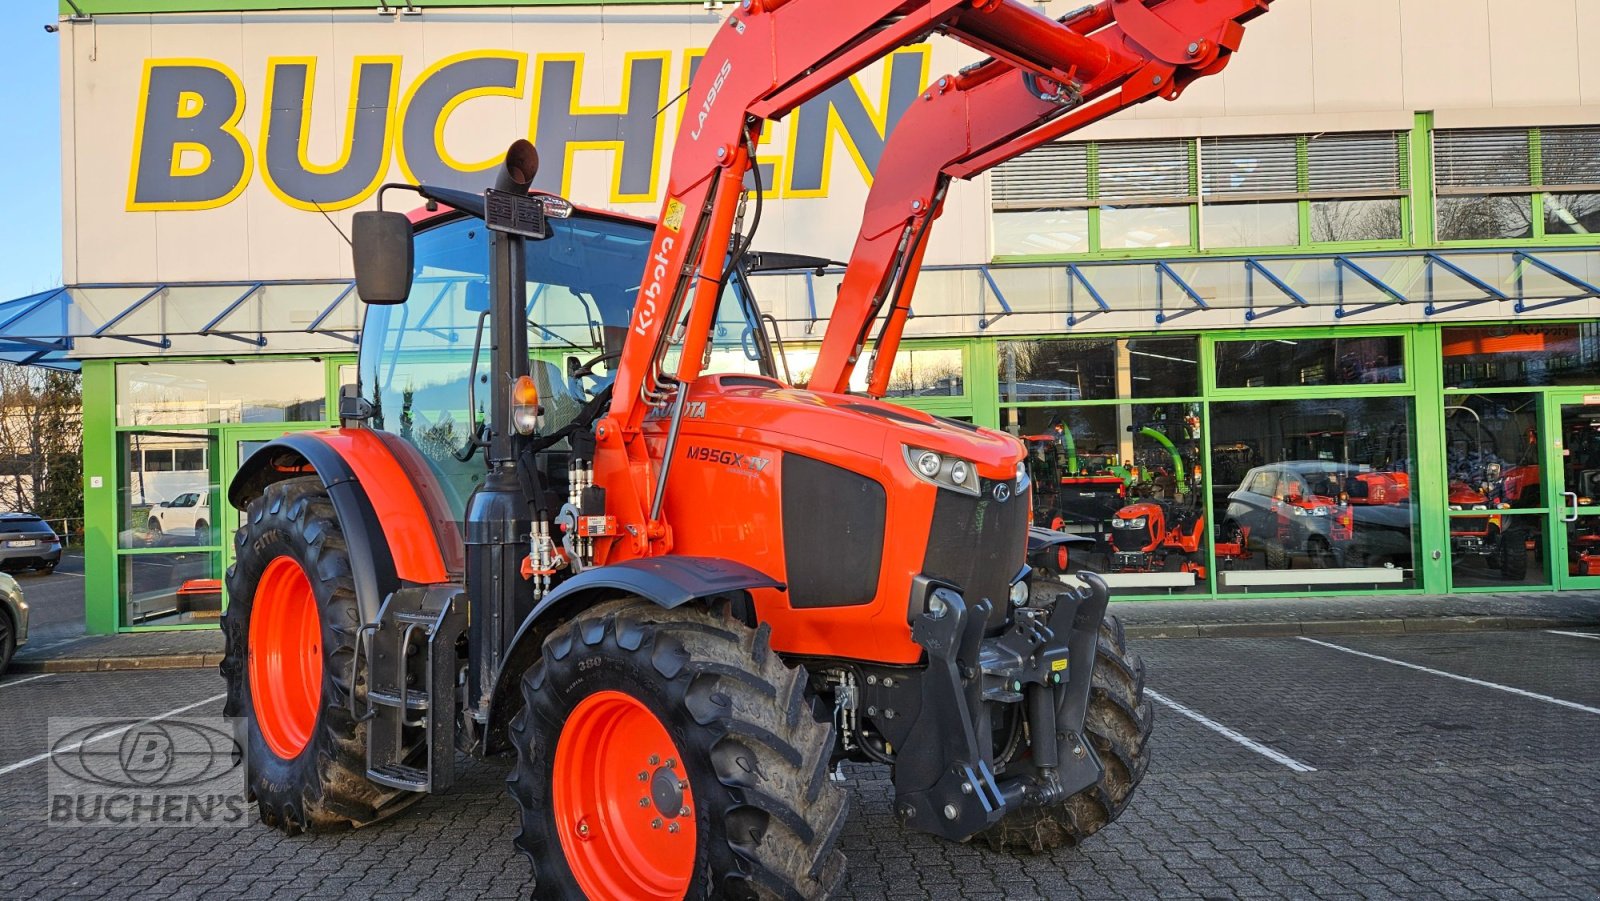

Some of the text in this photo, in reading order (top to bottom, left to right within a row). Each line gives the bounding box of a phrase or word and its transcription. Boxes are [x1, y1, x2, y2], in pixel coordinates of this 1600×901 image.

[125, 44, 932, 212] BUCHN
[691, 58, 732, 141] LA1955
[635, 236, 674, 336] Kubota
